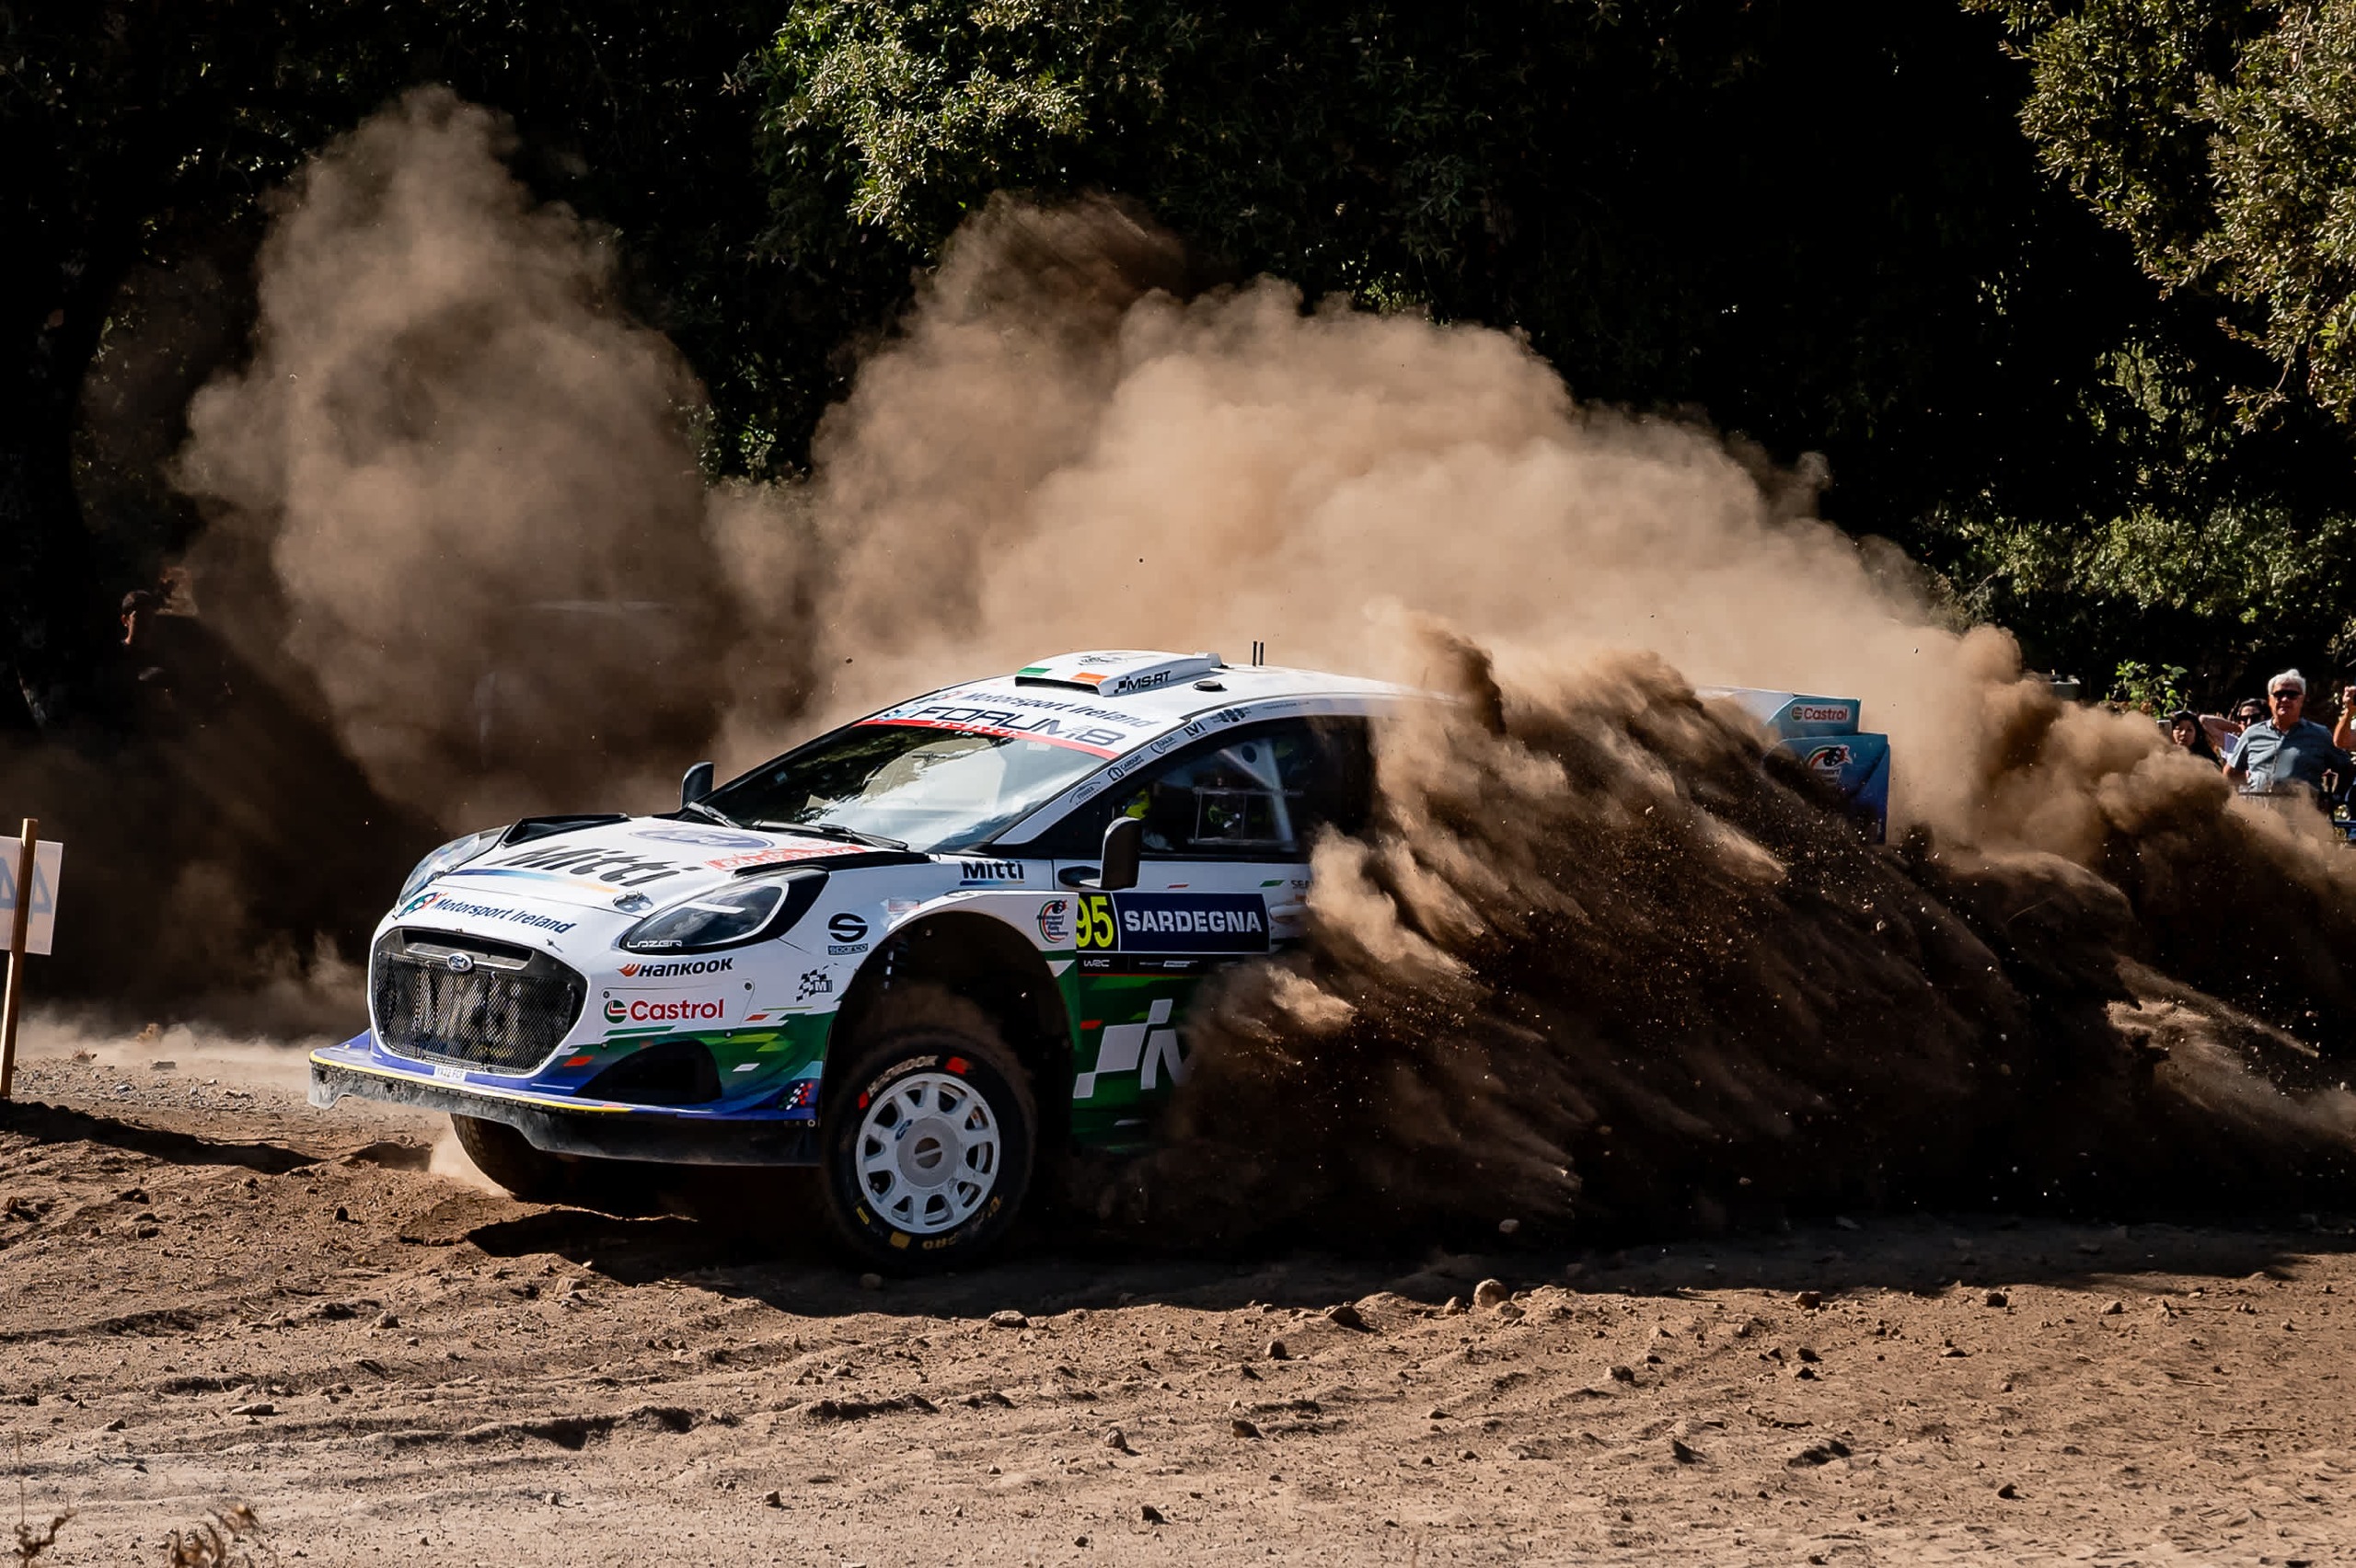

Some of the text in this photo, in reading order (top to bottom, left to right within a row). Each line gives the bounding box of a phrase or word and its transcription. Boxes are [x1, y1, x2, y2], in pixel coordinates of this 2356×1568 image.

[962, 691, 1161, 728] Motorsport Ireland
[1804, 708, 1848, 721] Castrol
[484, 845, 702, 887] Mitti
[962, 859, 1024, 880] Mitti
[432, 898, 577, 934] Motorsport Ireland
[1076, 896, 1114, 948] 95
[1125, 910, 1262, 933] SARDEGNA
[630, 997, 724, 1021] Castrol
